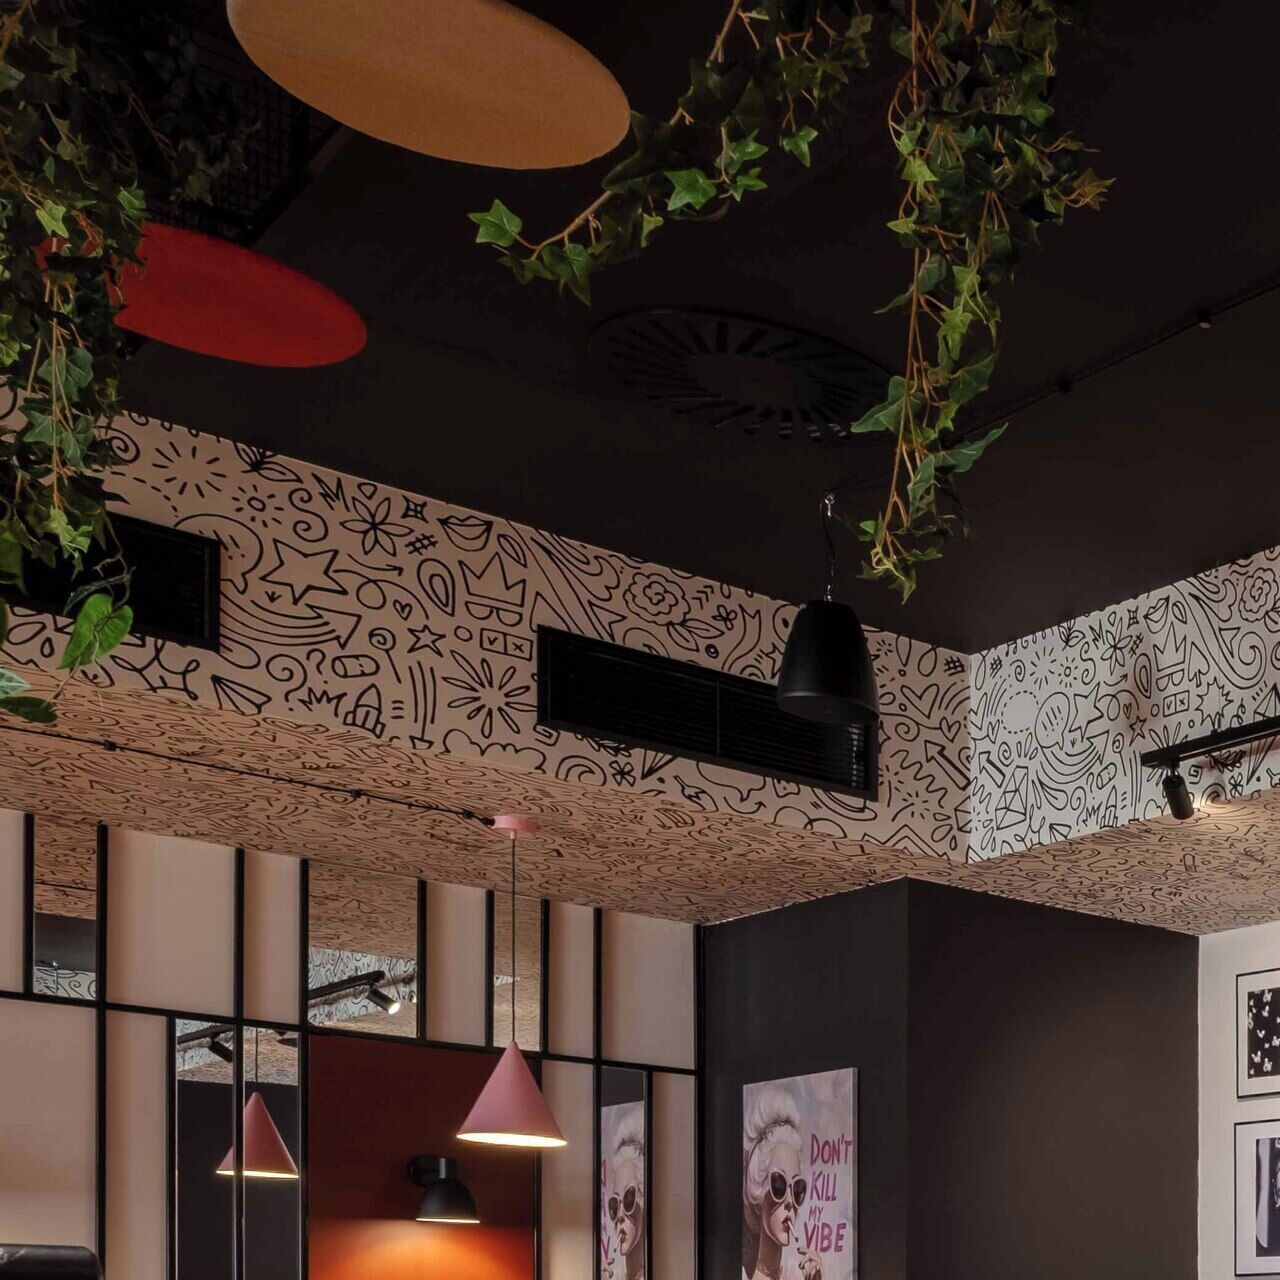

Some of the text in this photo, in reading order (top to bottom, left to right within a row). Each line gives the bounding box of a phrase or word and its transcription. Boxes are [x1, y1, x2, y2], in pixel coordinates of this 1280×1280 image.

[809, 1132, 852, 1167] DON'T
[809, 1169, 838, 1202] KILL
[808, 1205, 824, 1222] MY
[803, 1221, 847, 1253] VIBE
